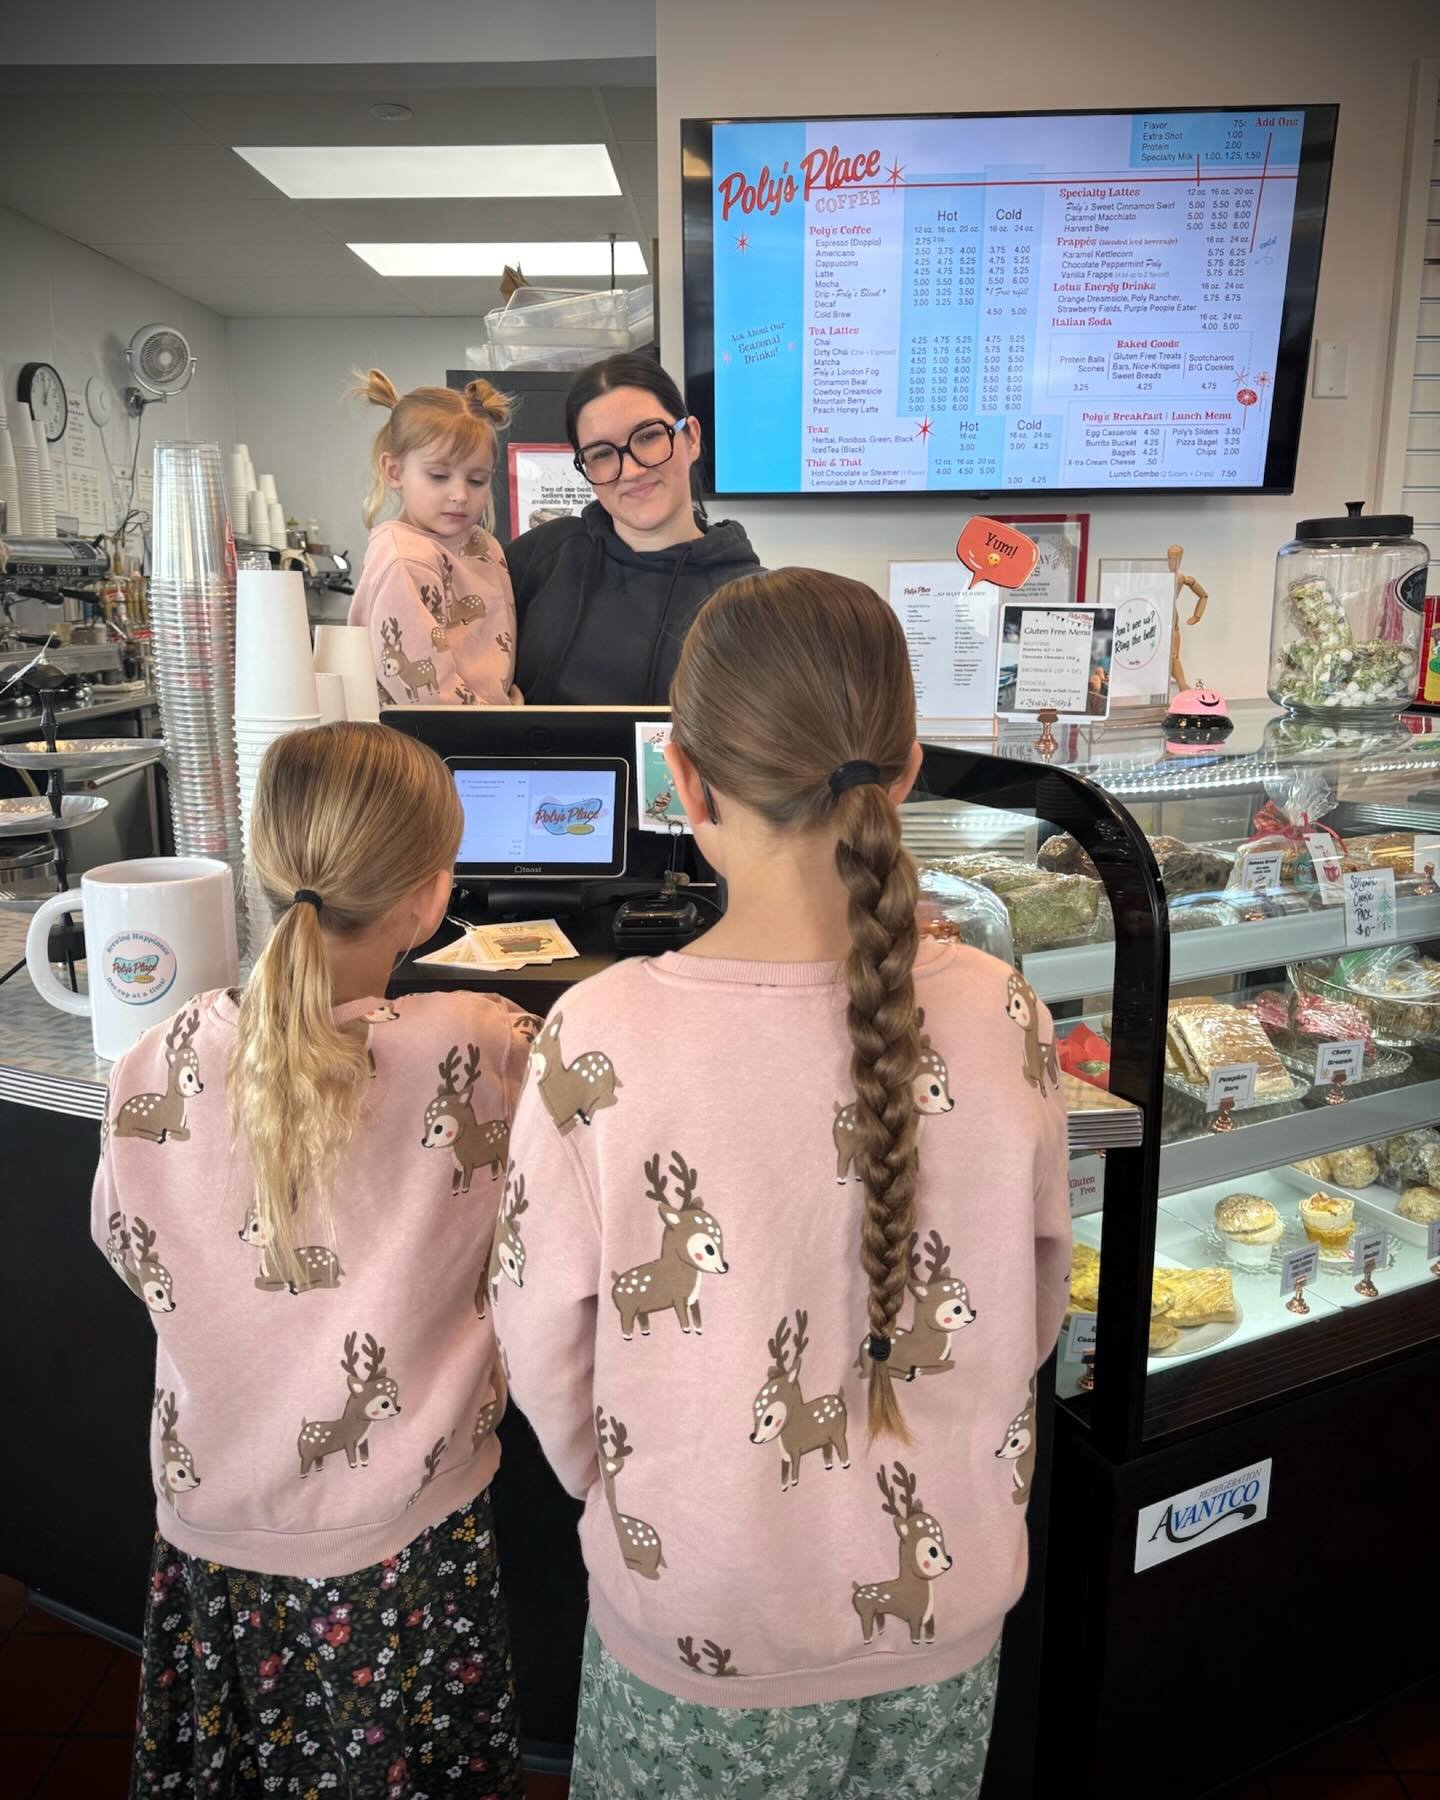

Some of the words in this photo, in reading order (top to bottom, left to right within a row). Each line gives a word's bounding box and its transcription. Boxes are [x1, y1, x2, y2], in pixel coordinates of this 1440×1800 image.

[1144, 121, 1167, 130] Flavor
[1256, 117, 1275, 127] Add
[1143, 132, 1162, 140] Extra
[1164, 132, 1183, 140] Shot
[1142, 153, 1175, 162] Specialty
[1178, 152, 1193, 160] Milk
[719, 162, 799, 221] Poly's
[800, 145, 881, 201] Place
[1060, 189, 1106, 199] Specialty
[1109, 188, 1140, 198] Lattes
[815, 191, 881, 213] COFFEE
[1118, 202, 1155, 210] Cinnamon
[1156, 202, 1175, 210] Swirl
[938, 210, 958, 221] Hot
[996, 209, 1022, 220] Cold
[1098, 213, 1136, 221] Macchiato
[840, 226, 871, 235] Coffee
[1094, 224, 1109, 232] Bee
[816, 239, 848, 247] Espresso
[850, 238, 881, 247] (Doppio)
[1063, 250, 1093, 258] Karamel
[815, 260, 858, 268] Cappuccino
[1062, 261, 1098, 269] Chocolate
[1101, 260, 1143, 269] Peppermint
[1061, 271, 1085, 279] Vanilla
[1054, 283, 1081, 292] Lotus
[1084, 283, 1119, 293] Energy
[1122, 282, 1156, 291] Drinks
[815, 290, 830, 298] Drip
[1058, 296, 1085, 304] Orange
[1131, 294, 1147, 303] Poly
[1058, 305, 1096, 313] Strawberry
[1124, 304, 1147, 313] Purple
[1149, 304, 1175, 313] People
[1177, 304, 1196, 312] Eater
[1052, 318, 1085, 327] Italian
[1088, 317, 1112, 326] Soda
[809, 327, 827, 335] Tea
[829, 327, 859, 335] Lattes
[738, 334, 780, 353] Seasonal
[814, 338, 830, 346] Chai
[1117, 340, 1147, 348] Baked
[1150, 339, 1179, 348] Goods
[814, 348, 830, 356] Dirty
[832, 348, 848, 356] Chai
[1114, 352, 1138, 360] Gluten
[1140, 352, 1157, 360] Free
[1159, 352, 1181, 360] Treats
[814, 358, 840, 366] Matcha
[1087, 355, 1105, 363] Balls
[1189, 354, 1234, 362] Scotcharoos
[1078, 365, 1104, 373] Scones
[1205, 363, 1234, 371] Cookies
[1112, 372, 1135, 380] Sweet
[814, 378, 849, 386] Cinnamon
[1201, 382, 1217, 390] 4.75
[813, 388, 841, 396] Cowboy
[848, 397, 866, 406] Berry
[813, 406, 835, 414] Peach
[837, 406, 859, 414] Honey
[1112, 412, 1163, 421] Breakfast
[1172, 412, 1202, 420] Lunch
[1205, 412, 1232, 420] Menu
[960, 421, 979, 431] Hot
[1017, 420, 1042, 430] Cold
[1086, 429, 1100, 437] Egg
[1102, 428, 1137, 436] Casserole
[1173, 428, 1193, 436] Poly's
[1195, 427, 1219, 435] Sliders
[1086, 439, 1110, 447] Burrito
[1112, 439, 1136, 447] Bucket
[1177, 438, 1194, 446] Pizza
[1196, 438, 1218, 447] Bagel
[841, 446, 865, 454] (Black)
[1112, 448, 1136, 457] Bagels
[1196, 447, 1216, 456] Chips
[806, 459, 827, 467] This
[1085, 458, 1108, 466] Cream
[1109, 470, 1131, 478] Lunch
[1134, 470, 1159, 478] Combo
[858, 478, 880, 486] Arnold
[985, 532, 1018, 558] Yum!
[1143, 610, 1155, 624] us?
[1024, 627, 1048, 635] Gluten
[1115, 640, 1130, 654] Ring
[1132, 633, 1141, 645] the
[535, 809, 566, 824] Poly's
[568, 808, 599, 822] Place
[133, 933, 170, 956] Happiness
[112, 962, 132, 974] Poly's
[133, 964, 158, 975] Place
[1218, 1073, 1247, 1083] Pumpkin
[1070, 1176, 1095, 1188] Gluten
[1081, 1187, 1095, 1196] Free
[1199, 1468, 1263, 1499] REFRIGERATION
[1148, 1480, 1260, 1543] AVANTCO
